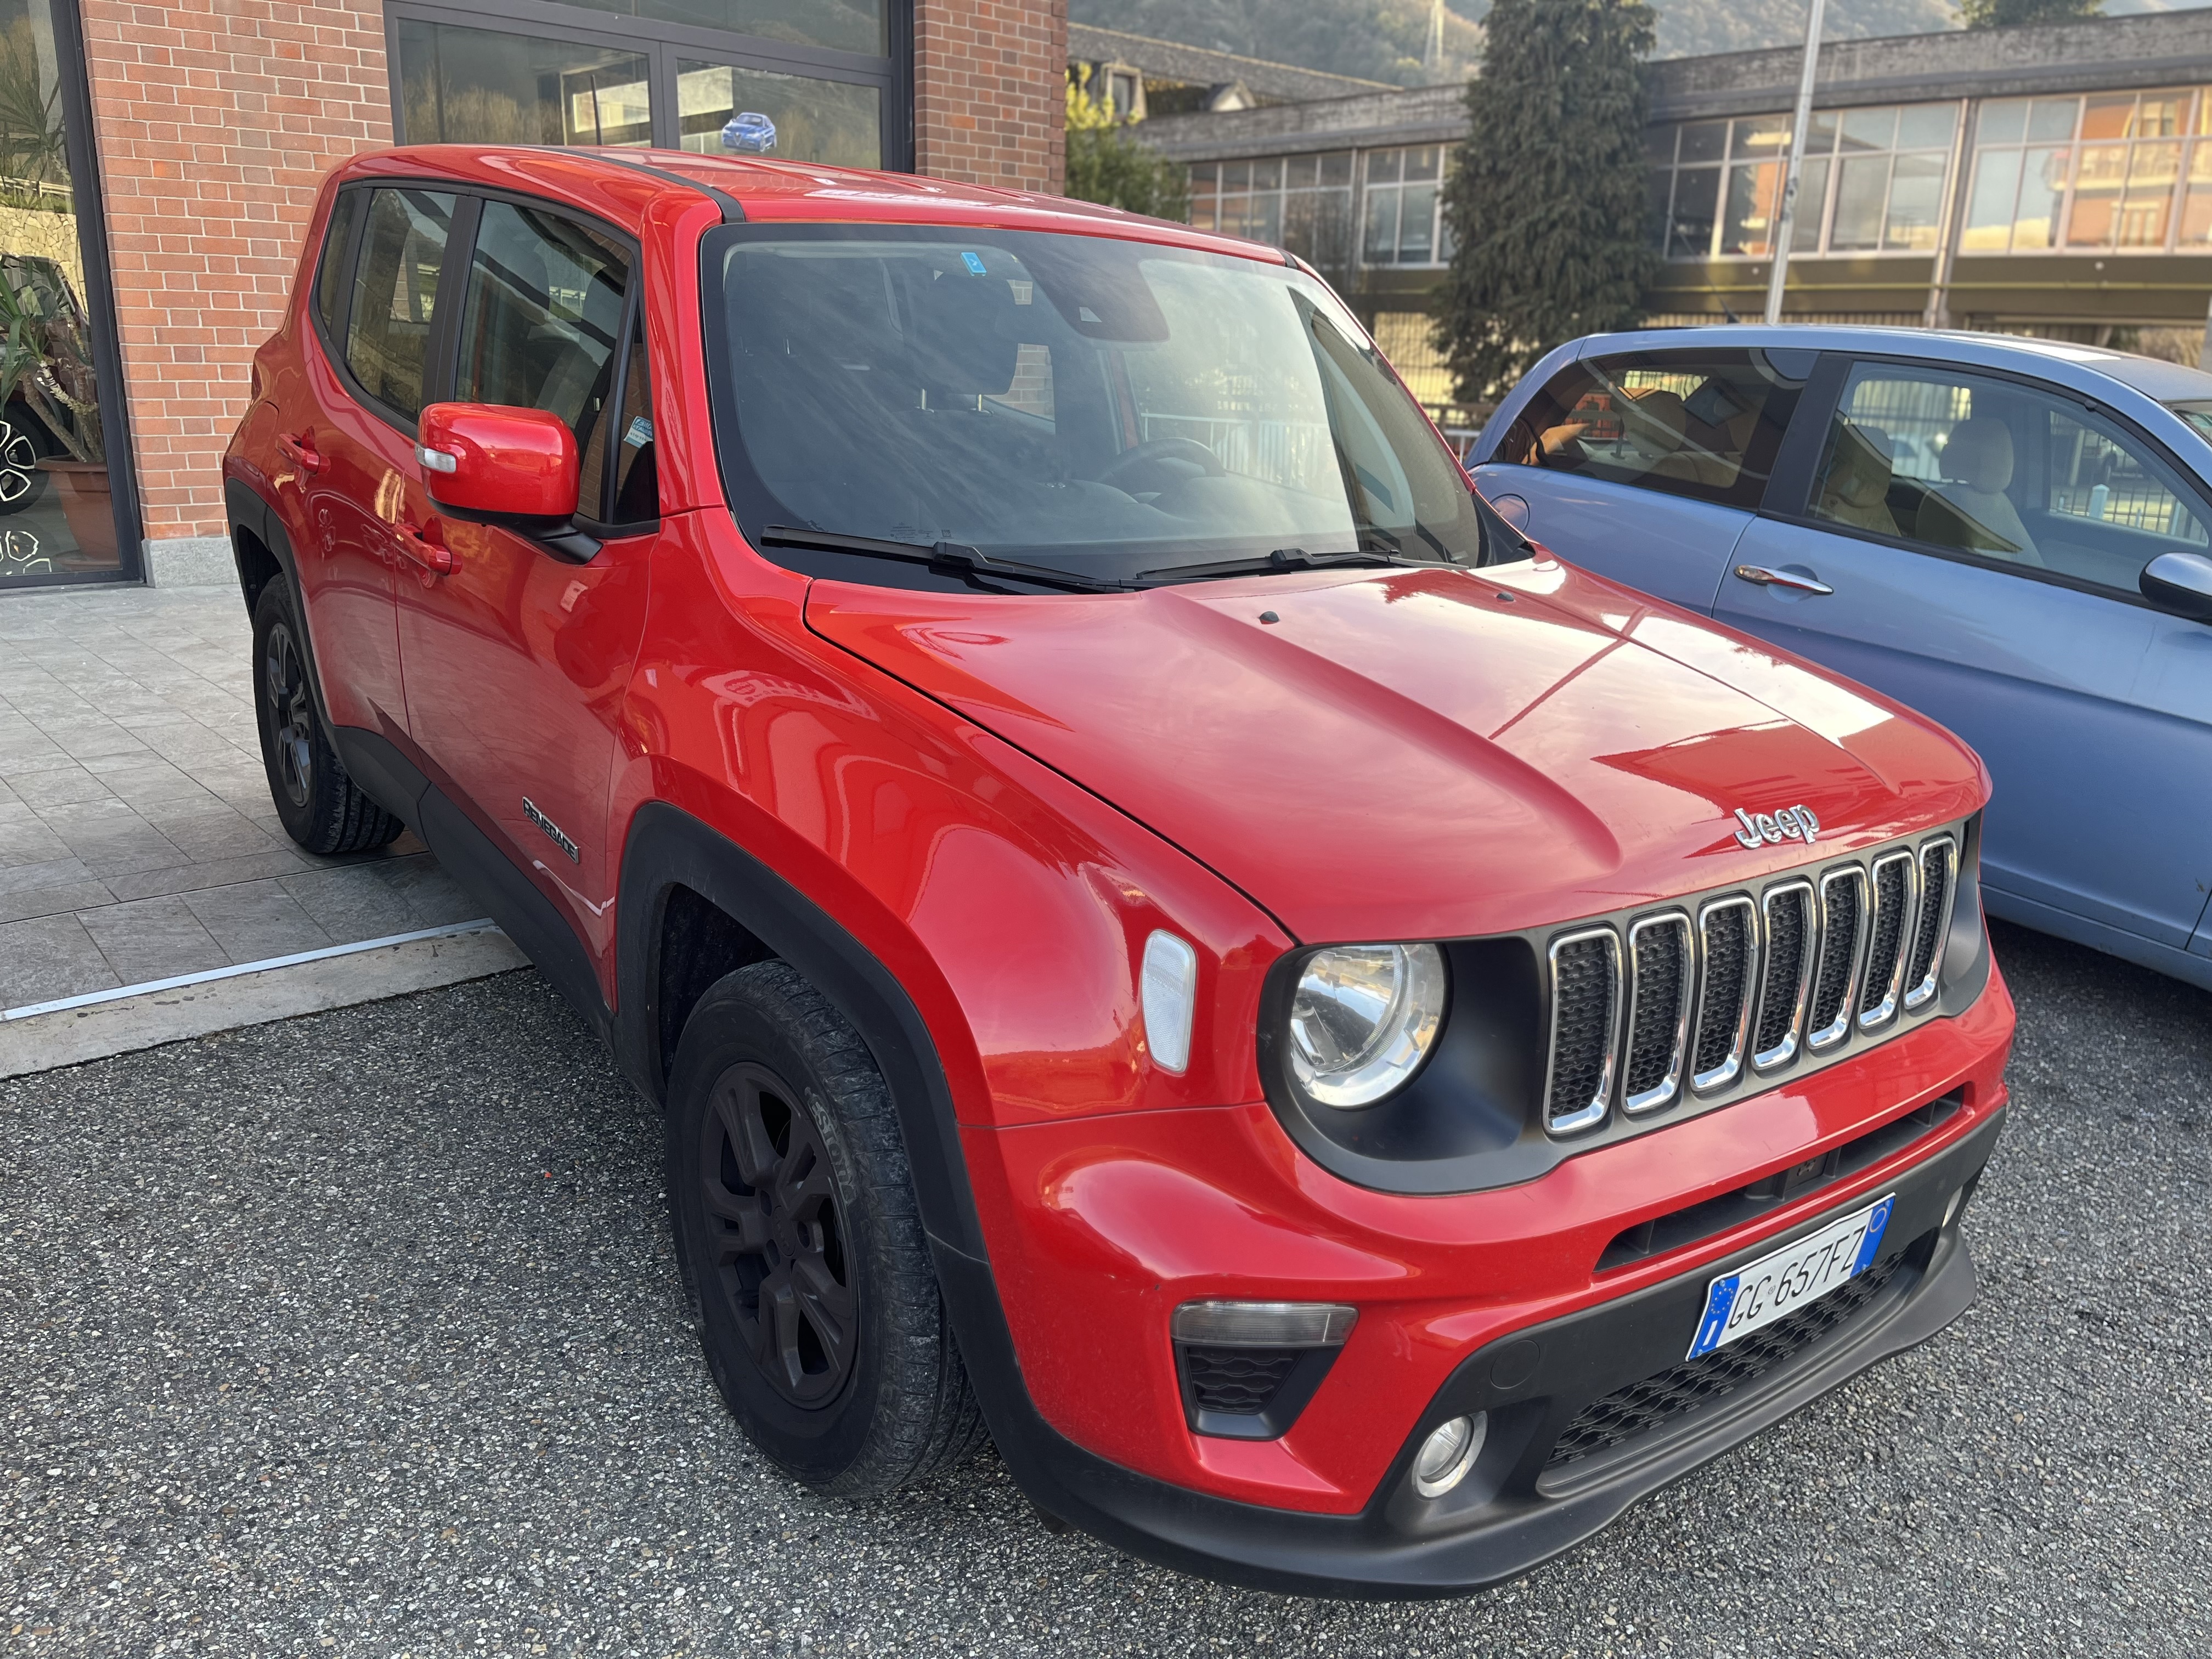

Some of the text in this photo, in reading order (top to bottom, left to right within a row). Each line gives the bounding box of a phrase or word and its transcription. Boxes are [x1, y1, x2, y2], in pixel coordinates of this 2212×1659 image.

[522, 797, 579, 864] RENEGADE
[1734, 804, 1820, 849] Jeep
[1728, 1276, 1771, 1329] GG
